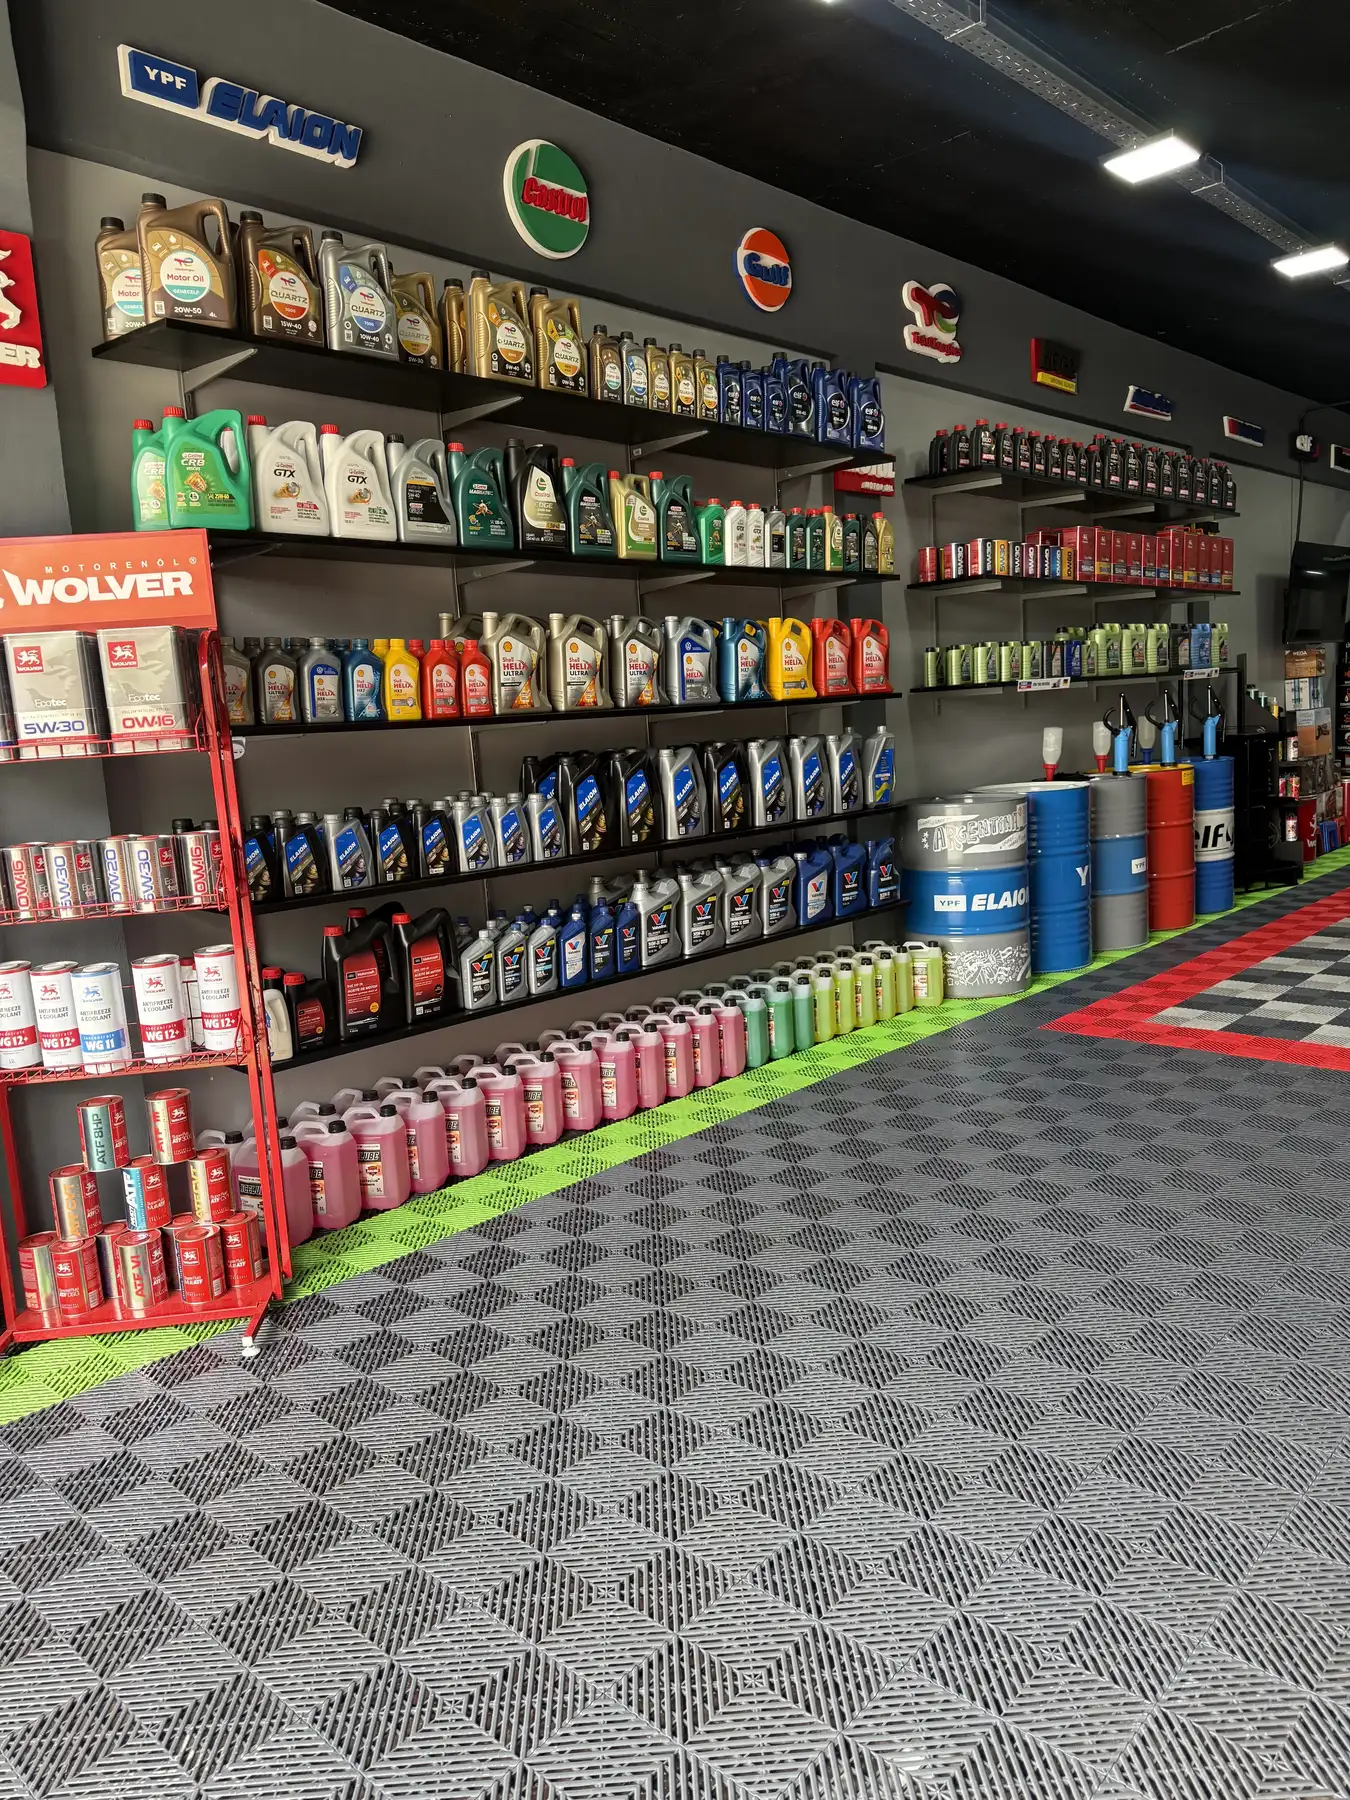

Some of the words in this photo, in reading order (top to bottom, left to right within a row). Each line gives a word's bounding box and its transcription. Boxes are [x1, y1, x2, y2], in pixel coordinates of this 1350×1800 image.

[144, 65, 186, 90] YPF
[207, 82, 362, 160] ELAION
[522, 177, 587, 222] Castrol
[744, 252, 789, 287] Gulf
[167, 274, 190, 282] Motor
[271, 290, 308, 303] QUARTZ
[351, 305, 385, 318] QUARTZ
[281, 320, 302, 329] 15W-40
[360, 334, 379, 342] 10W-40
[498, 338, 525, 349] QUARTZ
[555, 352, 579, 363] QUARTZ
[274, 470, 295, 478] GTX
[348, 475, 367, 484] GTX
[46, 558, 179, 573] MOTORENÖL
[2, 568, 194, 606] WOLVER
[503, 660, 528, 670] HELIX
[35, 699, 67, 707] Ecotec
[128, 694, 160, 702] Ecotec
[24, 720, 84, 734] 5W-30
[122, 714, 175, 728] 0W-16
[806, 767, 819, 786] ELAION
[841, 762, 853, 780] ELAION
[721, 773, 737, 793] ELAION
[765, 771, 780, 790] ELAION
[629, 782, 646, 804] ELAION
[676, 780, 693, 800] ELAION
[578, 787, 597, 810] ELAION
[503, 821, 517, 838] ELAION
[541, 819, 555, 834] ELAION
[382, 833, 398, 851] ELAION
[426, 828, 441, 846] ELAION
[465, 828, 480, 845] ELAION
[246, 849, 259, 865] AION
[290, 843, 307, 863] ELAION
[339, 842, 356, 861] ELAION
[190, 845, 208, 894] 0W-16
[971, 888, 1028, 911] ELAIO
[201, 988, 229, 996] ANTIFREEZE
[142, 998, 173, 1007] ANTIFREEZE
[147, 1004, 173, 1012] COOLANT
[38, 1006, 68, 1014] ANTIFREEZE
[80, 1008, 111, 1016] ANTIFREEZE
[204, 1018, 219, 1028] WG
[219, 1017, 236, 1027] 12+
[11, 1036, 29, 1047] 12+
[146, 1031, 162, 1041] WG
[163, 1029, 179, 1039] 12+
[43, 1038, 58, 1049] WG
[59, 1037, 76, 1048] 12+
[86, 1041, 104, 1051] WG
[106, 1039, 115, 1049] 11
[240, 1183, 262, 1196] ICELU
